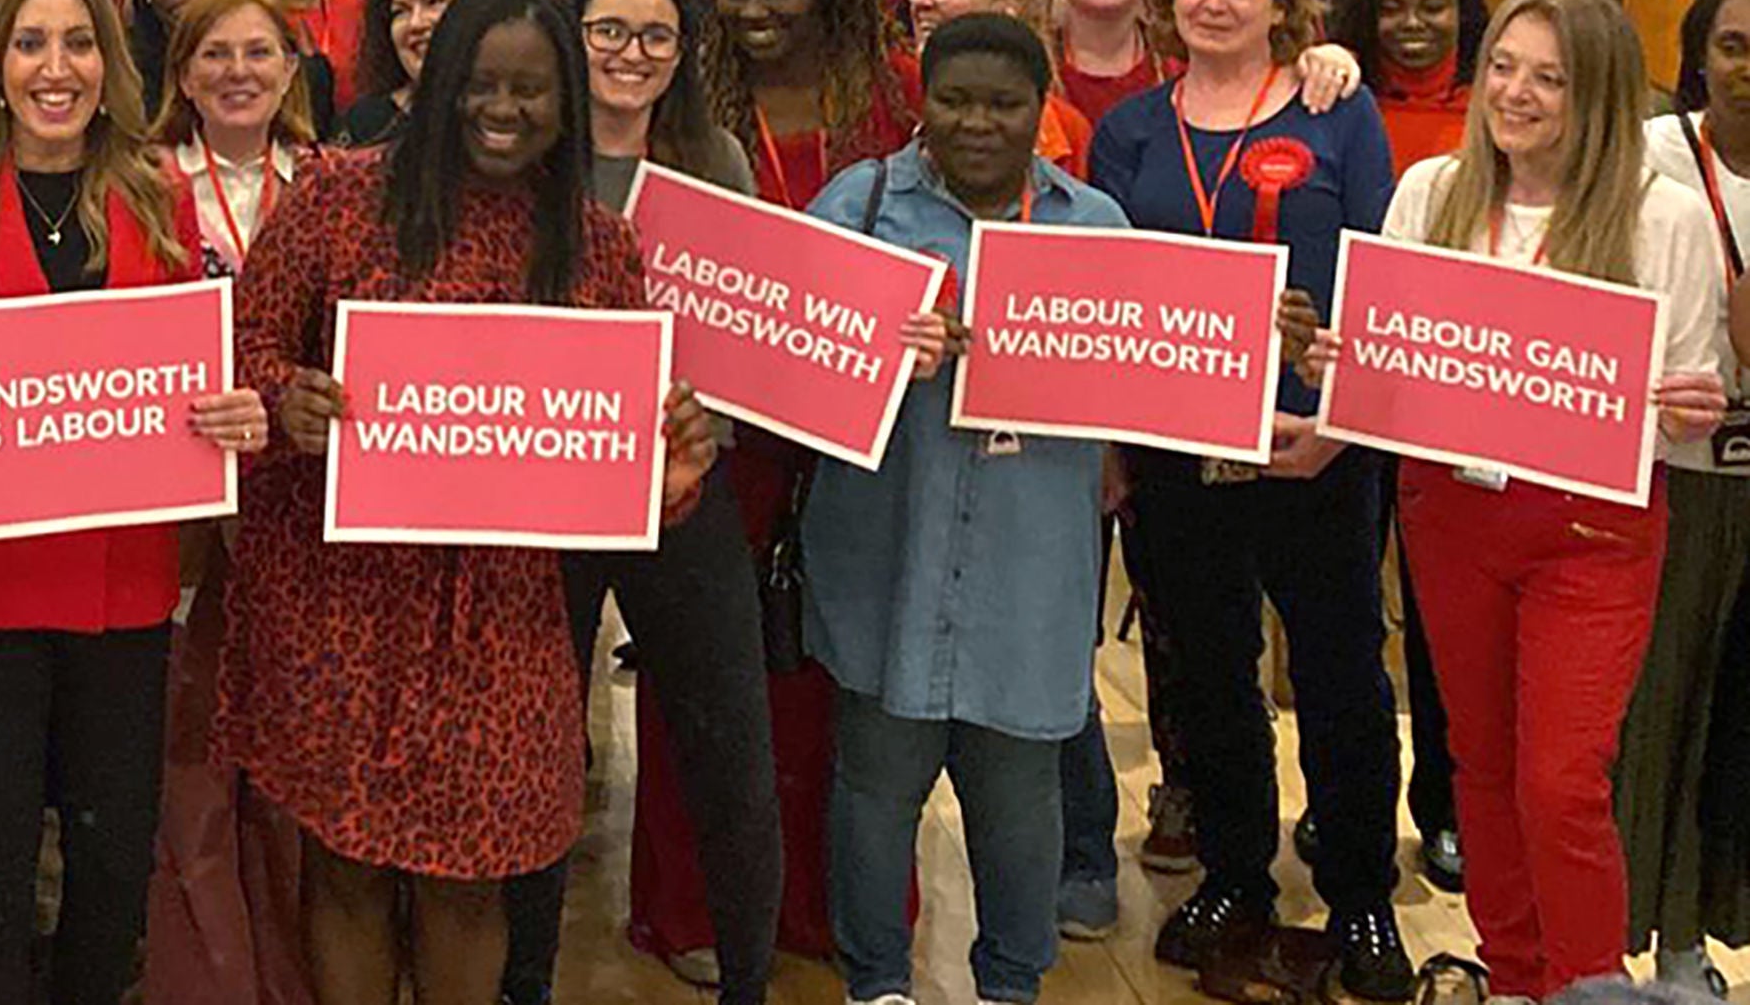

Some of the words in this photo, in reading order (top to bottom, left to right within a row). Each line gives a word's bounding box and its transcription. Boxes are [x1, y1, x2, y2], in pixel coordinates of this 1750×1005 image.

[652, 243, 790, 312] LABOUR
[803, 292, 878, 345] WIN
[1006, 293, 1143, 329] LABOUR
[1160, 305, 1236, 341] WIN
[987, 327, 1249, 381] WANDSWORTH
[1366, 306, 1512, 358] LABOUR
[1526, 338, 1619, 385] GAIN
[377, 383, 525, 416] LABOUR
[541, 388, 621, 421] WIN
[1353, 338, 1627, 424] WANDSWORTH
[16, 406, 166, 448] LABOUR
[357, 423, 636, 462] WANDSWORTH
